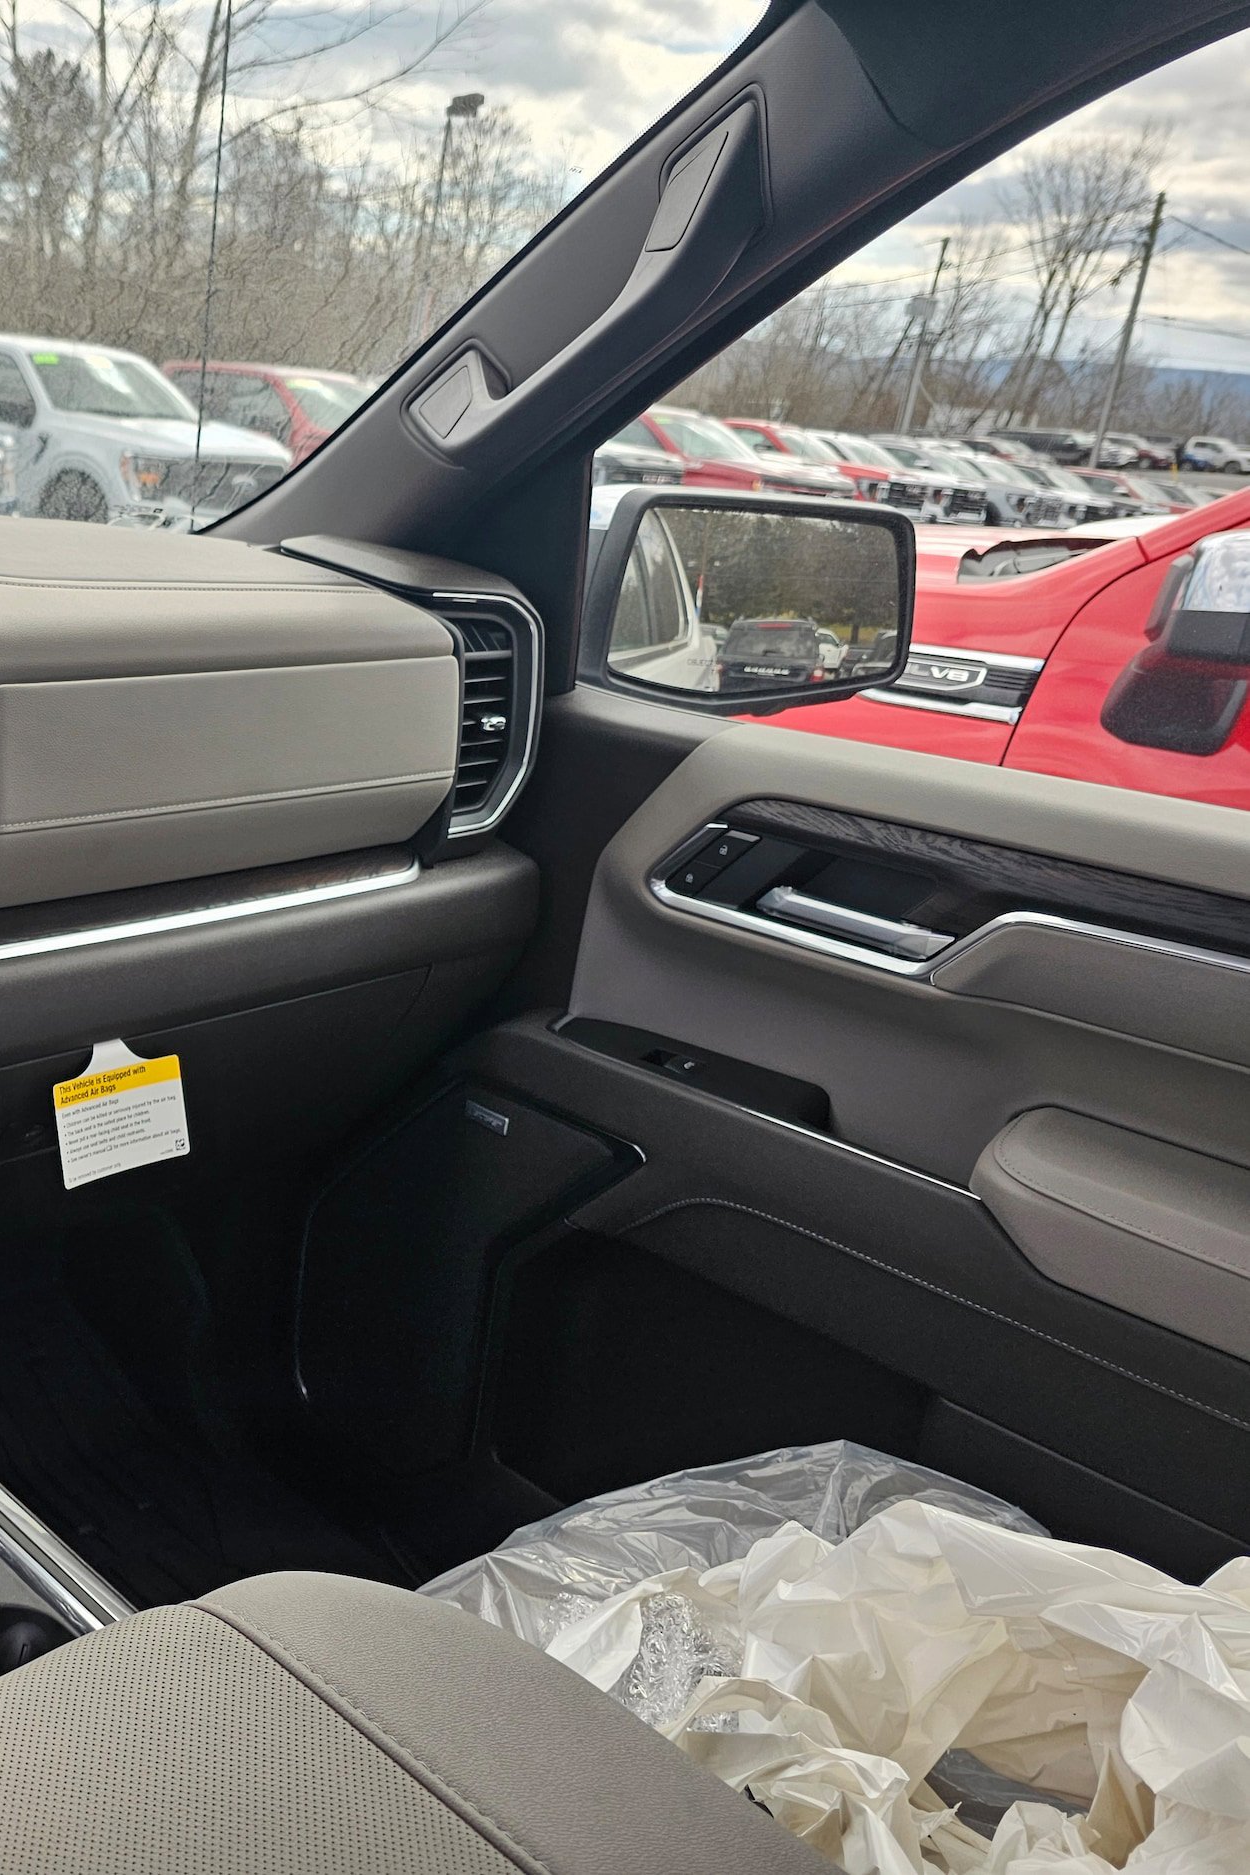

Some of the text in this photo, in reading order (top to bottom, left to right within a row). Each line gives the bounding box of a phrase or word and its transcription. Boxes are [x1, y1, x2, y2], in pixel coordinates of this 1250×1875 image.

[930, 665, 969, 682] V8
[59, 1085, 71, 1094] This
[72, 1078, 94, 1090] Vehicle
[102, 1068, 131, 1082] Equipped
[132, 1066, 146, 1074] with
[60, 1090, 88, 1104] Advanced
[100, 1084, 116, 1093] Bags
